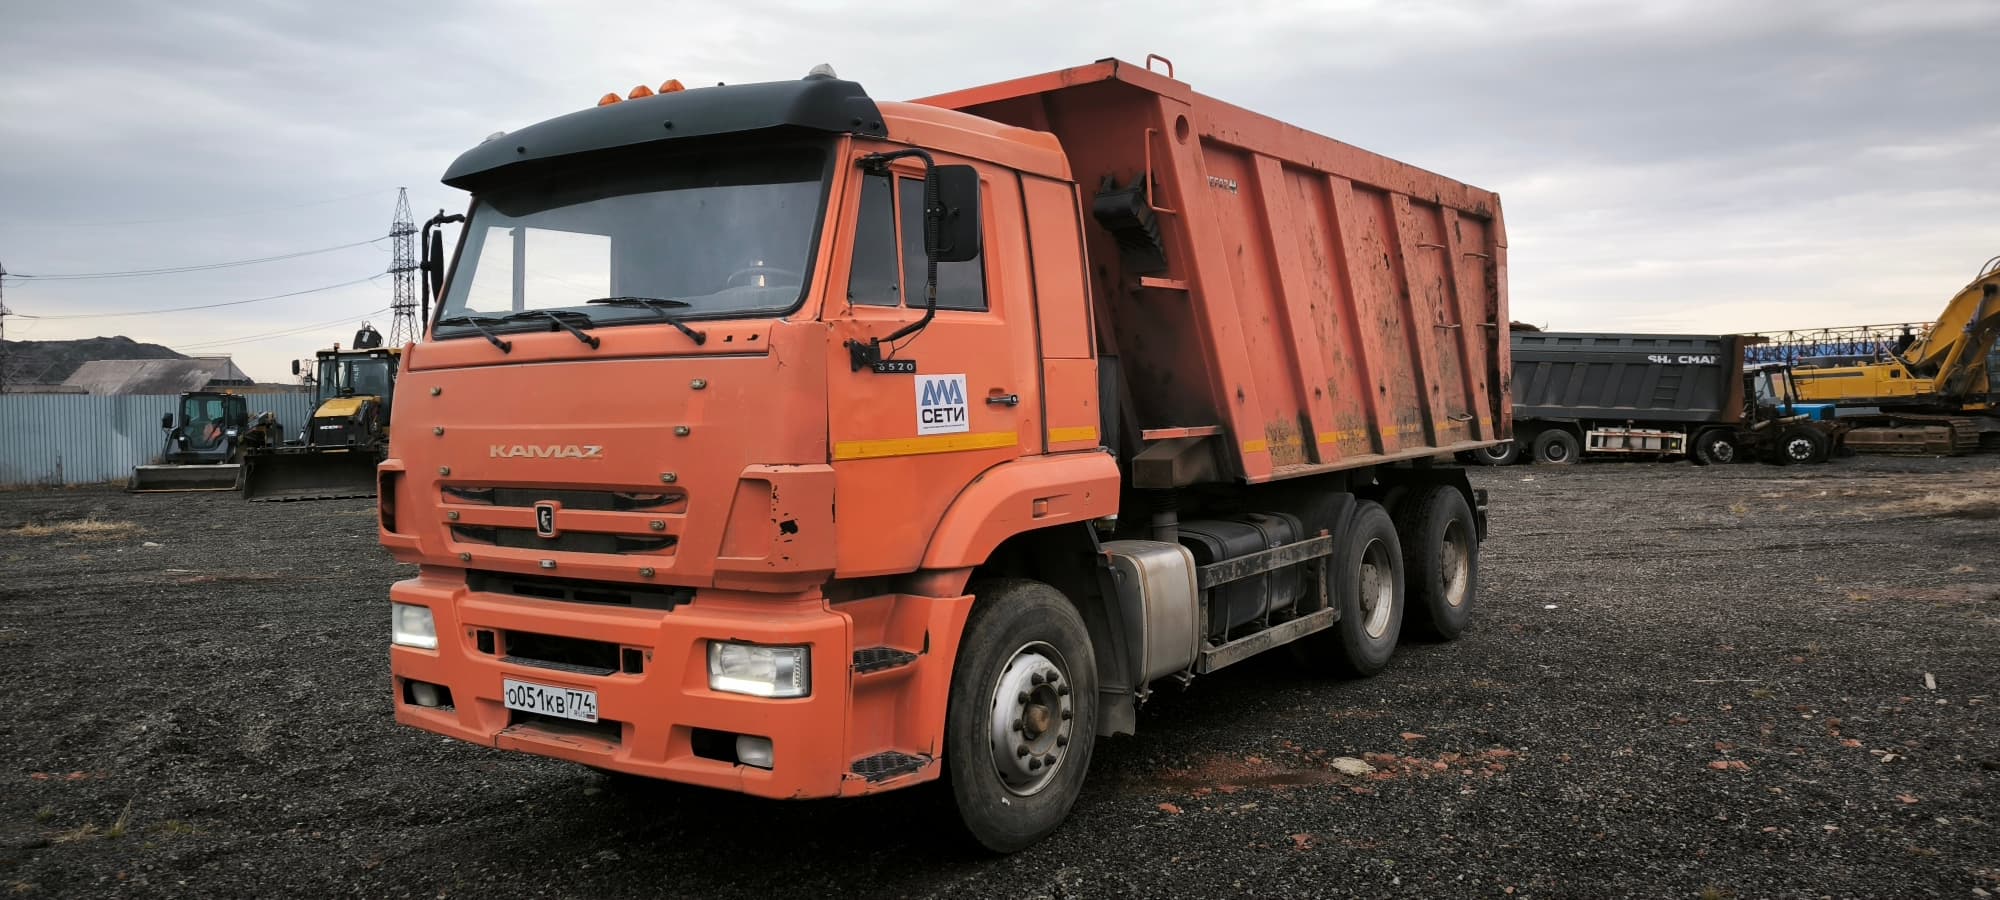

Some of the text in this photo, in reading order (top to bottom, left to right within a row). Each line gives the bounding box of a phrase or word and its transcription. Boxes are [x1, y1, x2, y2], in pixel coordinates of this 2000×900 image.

[878, 362, 914, 371] 6520
[921, 407, 965, 424] СЕТИ
[489, 444, 603, 459] KAMAZ
[567, 691, 592, 712] 774
